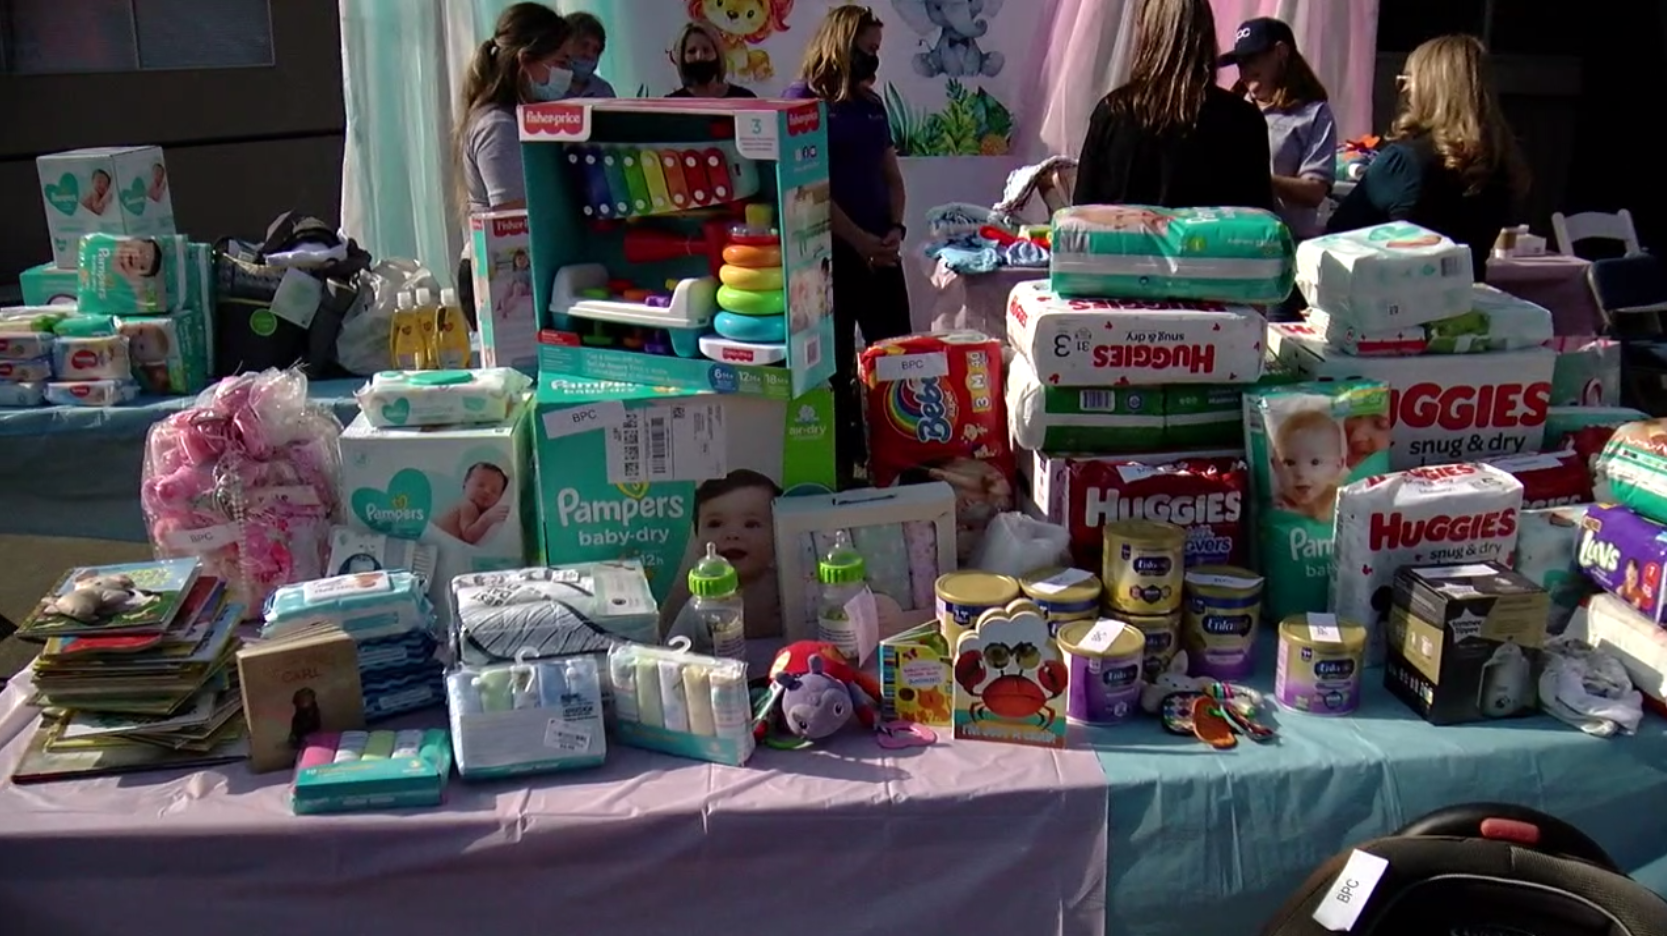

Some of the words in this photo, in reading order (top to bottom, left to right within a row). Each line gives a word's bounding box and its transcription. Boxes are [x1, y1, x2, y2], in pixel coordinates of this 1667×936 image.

[751, 118, 762, 135] 3
[1054, 334, 1072, 358] 3
[1126, 332, 1147, 344] dry
[1157, 331, 1185, 342] snug
[902, 360, 924, 371] BPC
[1093, 344, 1215, 374] HUGGIES
[572, 409, 597, 423] BPC
[915, 376, 952, 444] Beb
[1390, 382, 1552, 431] GGIES
[1409, 437, 1464, 458] snug
[1467, 434, 1483, 451] &
[1488, 432, 1526, 454] dry
[365, 503, 424, 521] Pampers
[558, 487, 685, 527] Pampers
[1085, 487, 1241, 528] HUGGIES
[1370, 507, 1516, 551] HUGGIES
[1429, 546, 1465, 560] snug
[1466, 543, 1476, 556] &
[1479, 541, 1501, 555] dry
[1336, 878, 1360, 904] BPC
